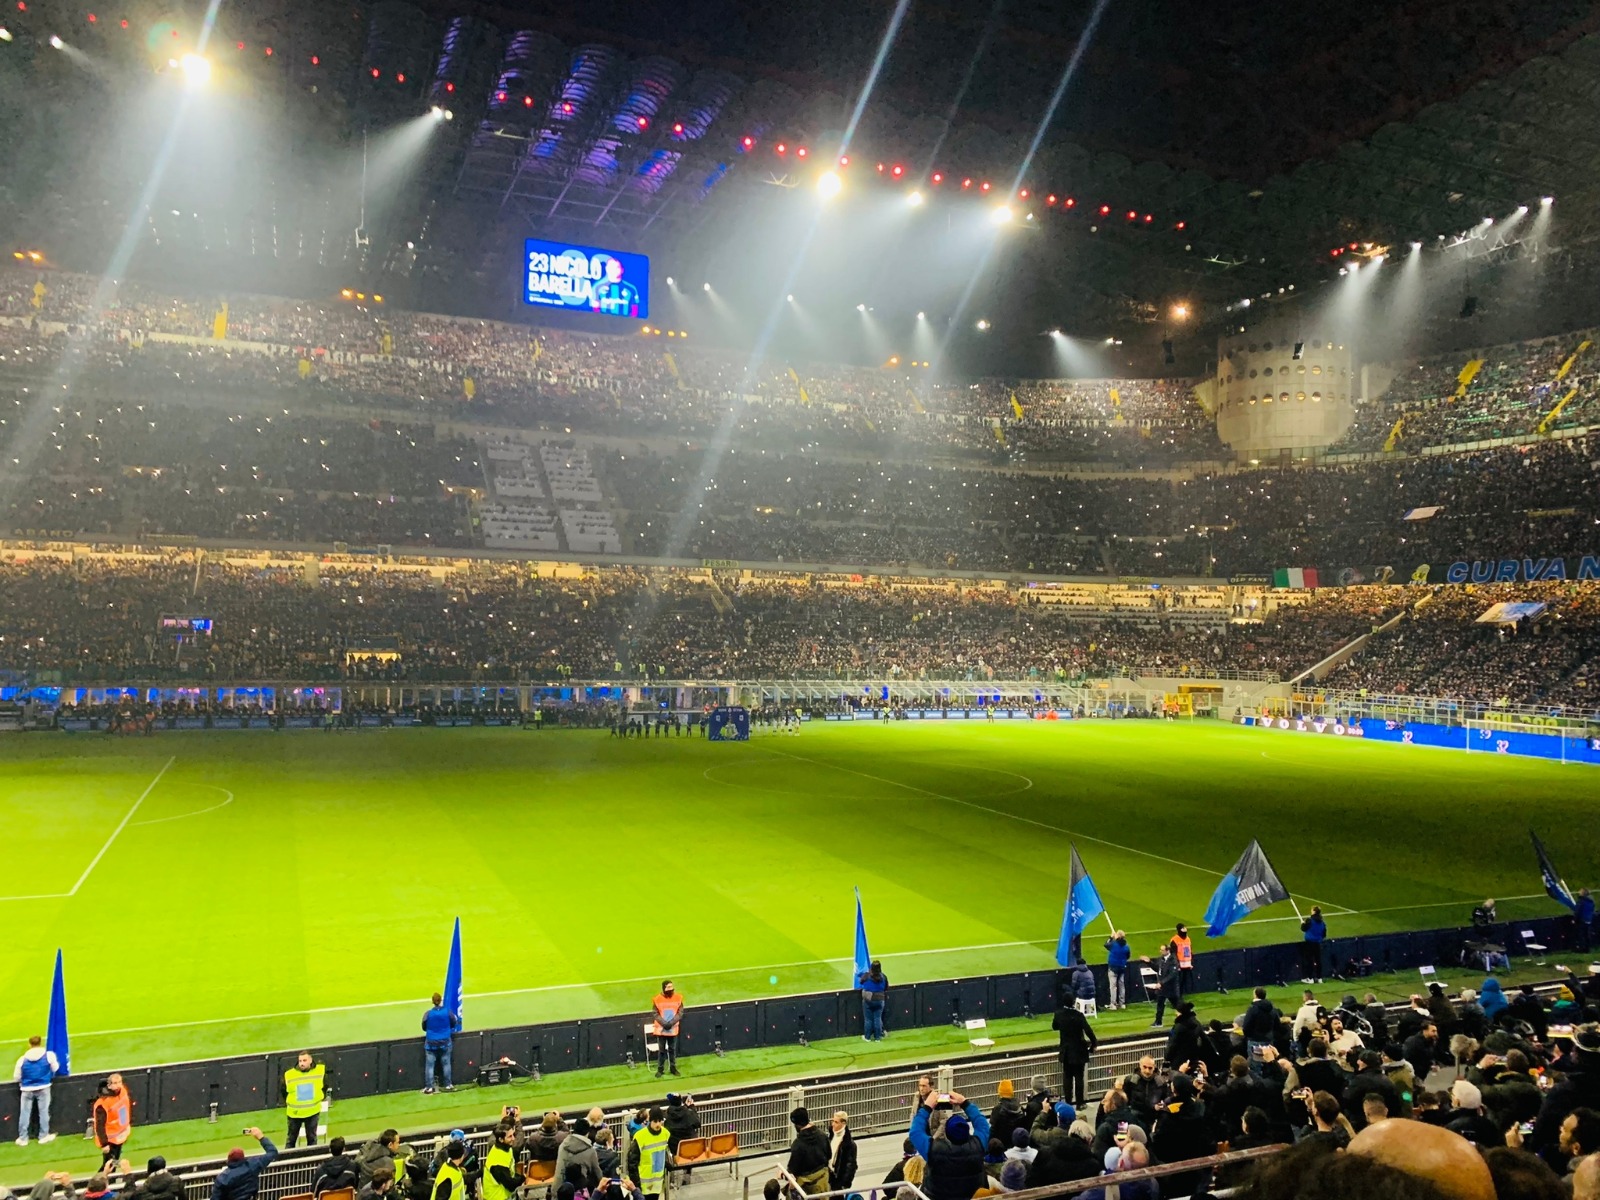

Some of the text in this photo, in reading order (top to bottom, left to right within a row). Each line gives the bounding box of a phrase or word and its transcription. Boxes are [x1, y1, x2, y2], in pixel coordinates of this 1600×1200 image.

[529, 252, 549, 273] 23
[1447, 557, 1566, 583] CURVA
[1261, 717, 1345, 735] VOLVO
